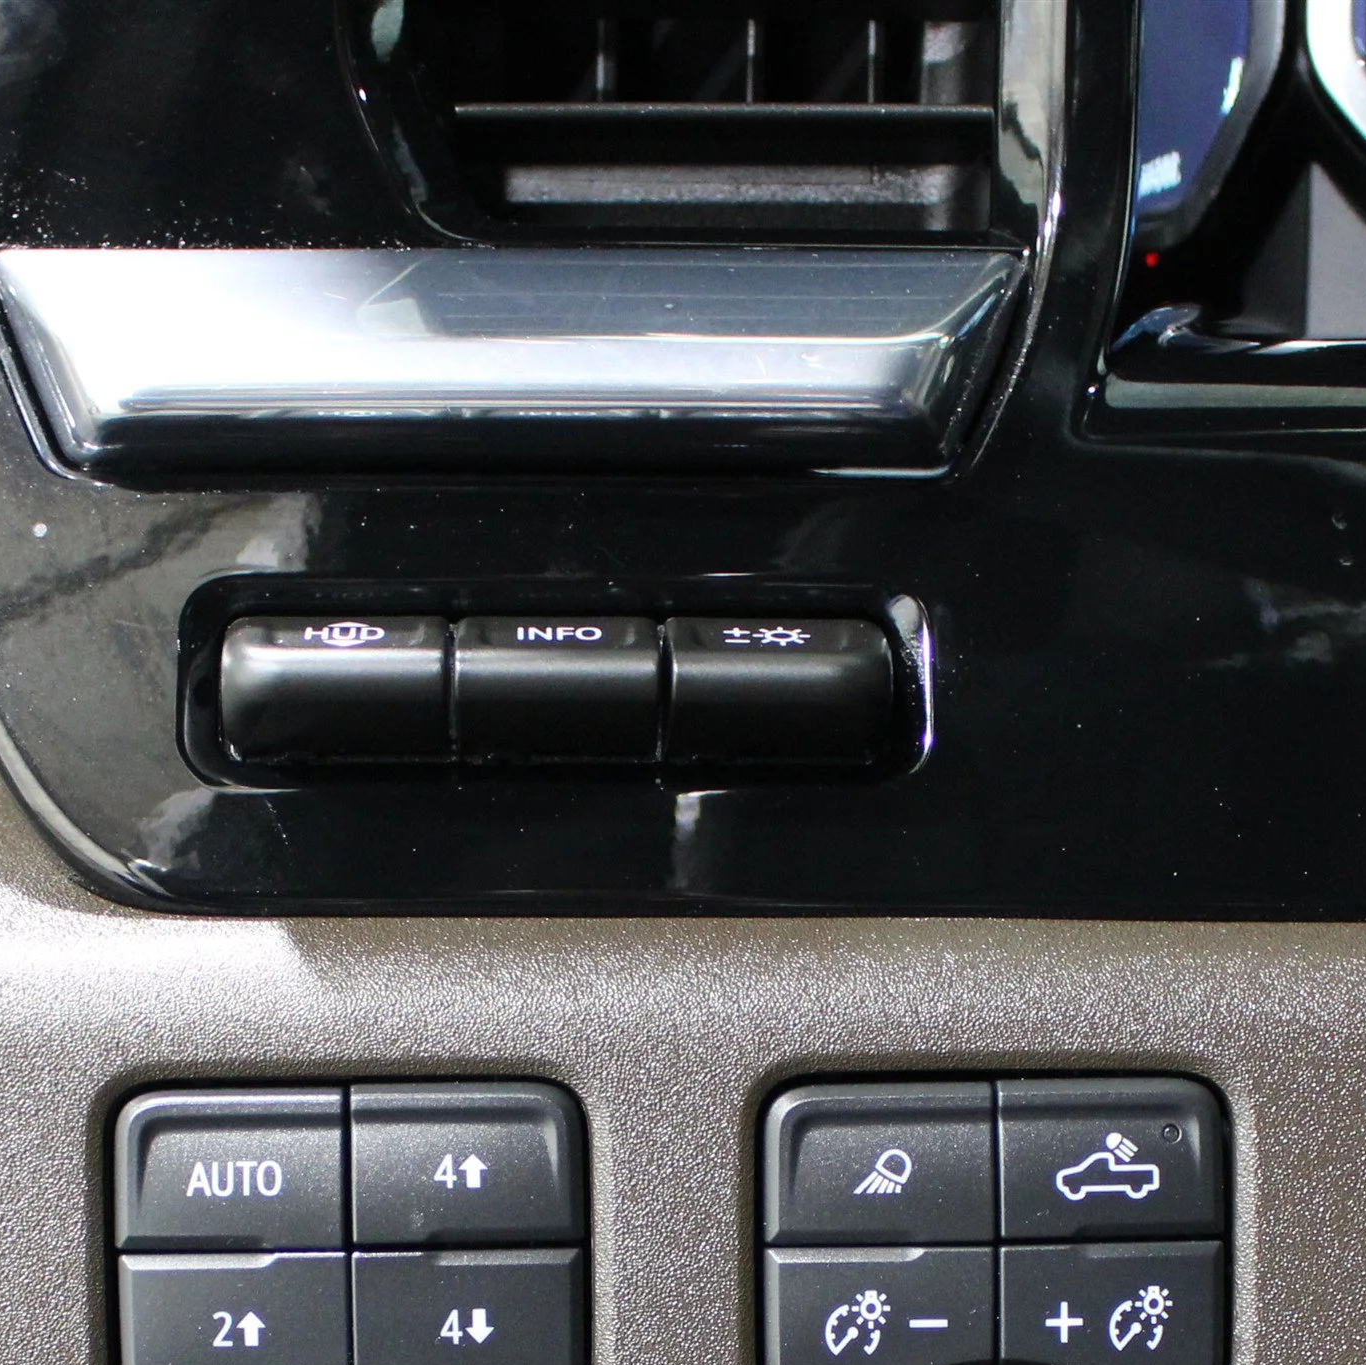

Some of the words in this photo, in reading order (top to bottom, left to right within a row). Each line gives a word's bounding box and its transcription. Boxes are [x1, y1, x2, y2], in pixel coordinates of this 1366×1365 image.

[303, 625, 386, 642] HUD
[516, 626, 603, 642] INFO
[185, 1161, 283, 1197] AUTO
